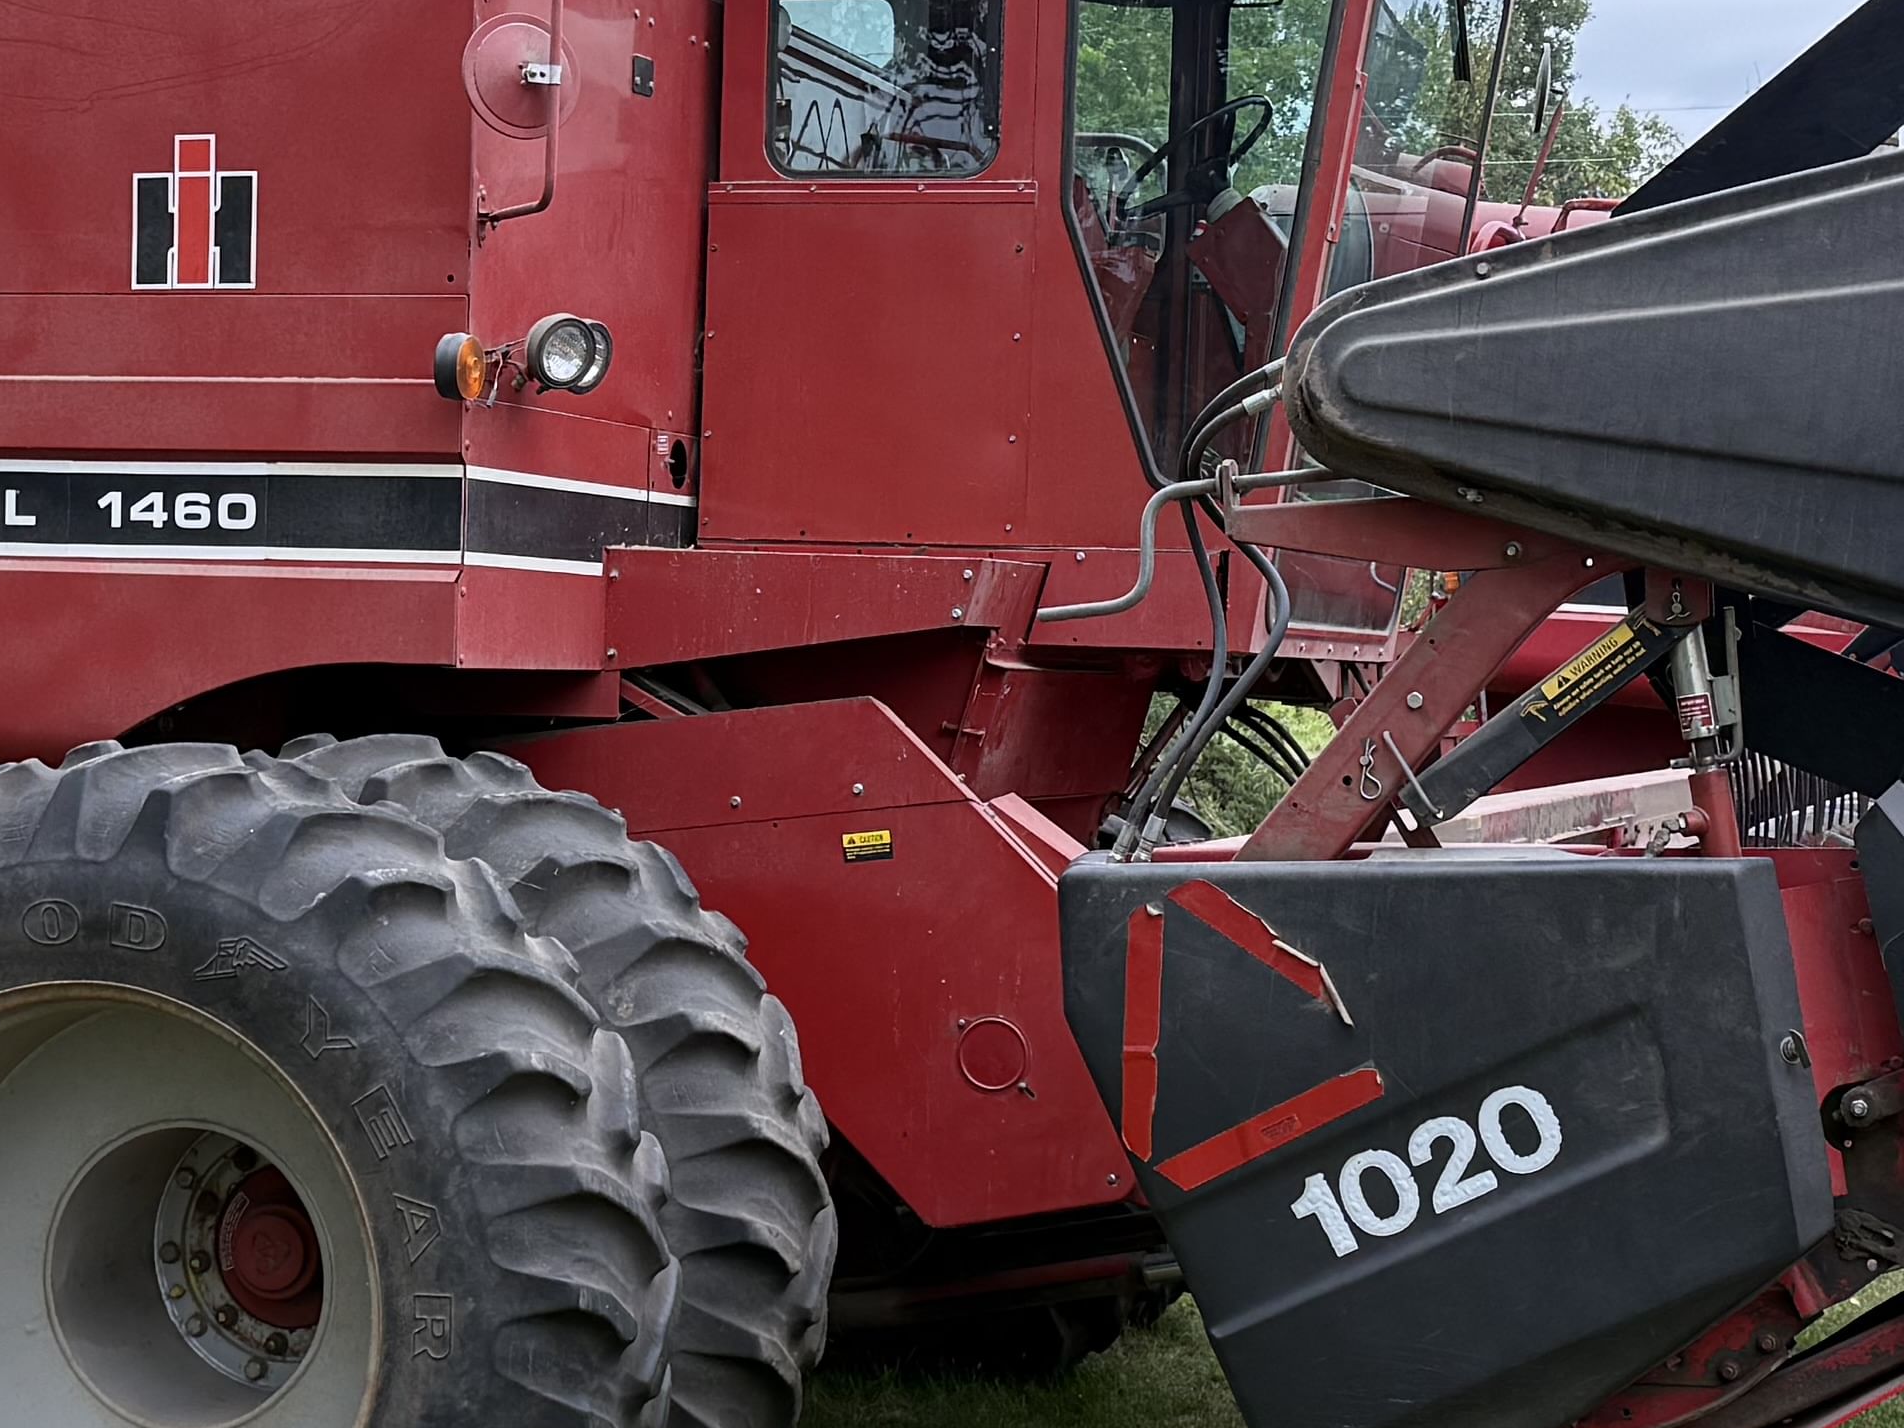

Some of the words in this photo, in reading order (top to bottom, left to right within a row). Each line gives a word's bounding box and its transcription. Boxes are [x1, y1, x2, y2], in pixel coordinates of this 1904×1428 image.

[97, 491, 257, 531] 1460
[1569, 636, 1620, 676] WARNING
[1290, 1084, 1563, 1258] 1020
